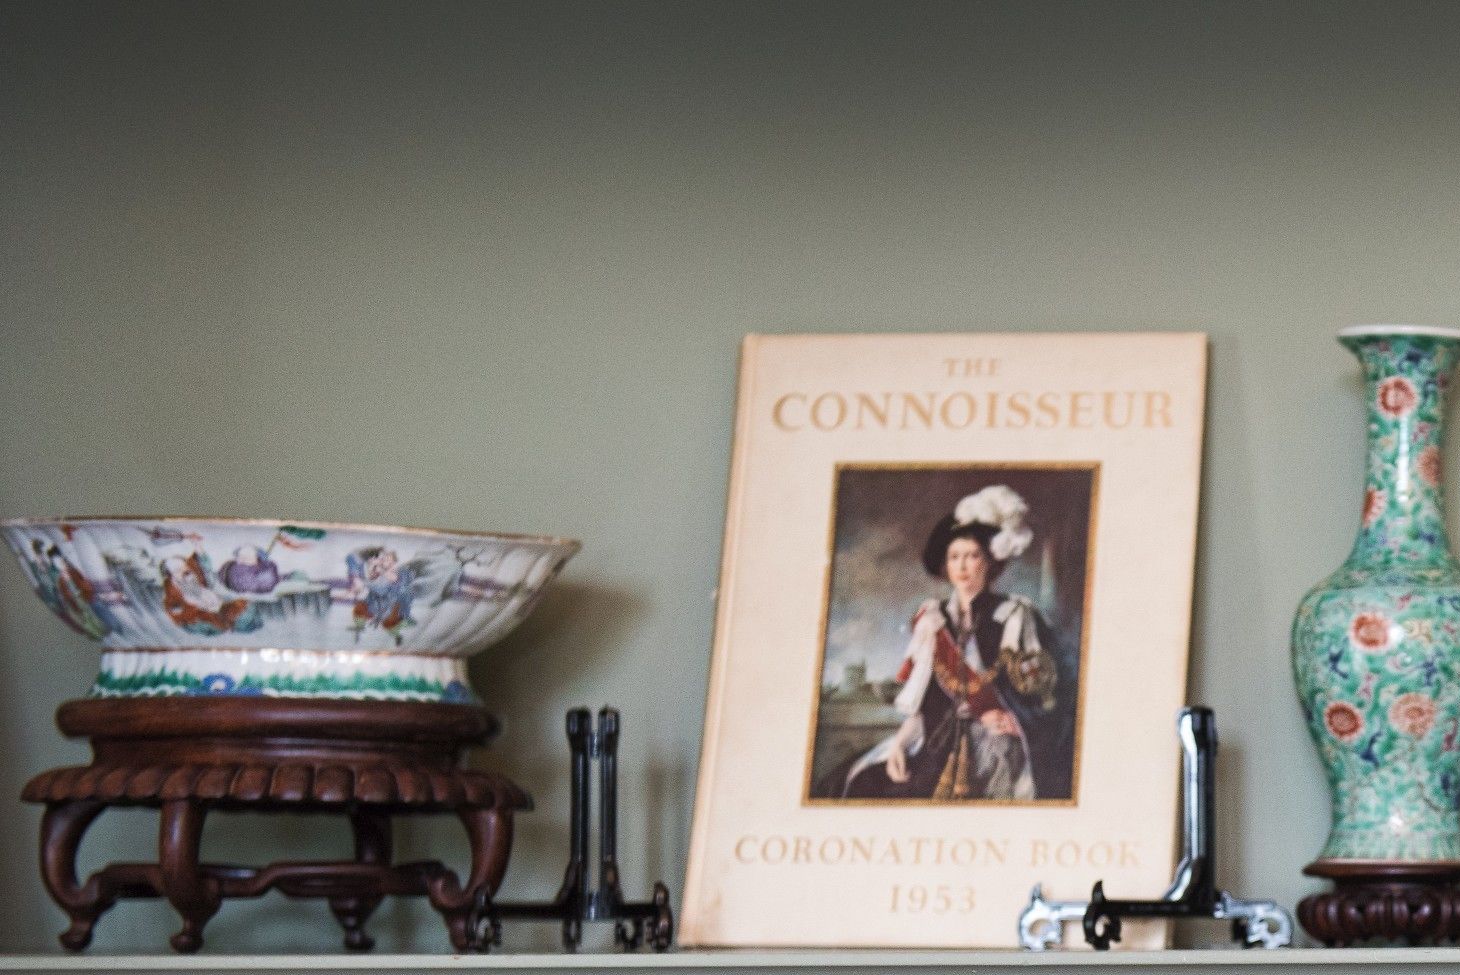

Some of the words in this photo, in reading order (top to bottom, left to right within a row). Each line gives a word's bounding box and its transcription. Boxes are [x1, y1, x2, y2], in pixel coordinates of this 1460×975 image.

[944, 357, 1001, 378] THE
[771, 391, 1175, 433] CONNOISSEUR
[734, 835, 1008, 865] CORONATION
[1030, 839, 1141, 868] BOOK
[890, 884, 977, 914] 1953
